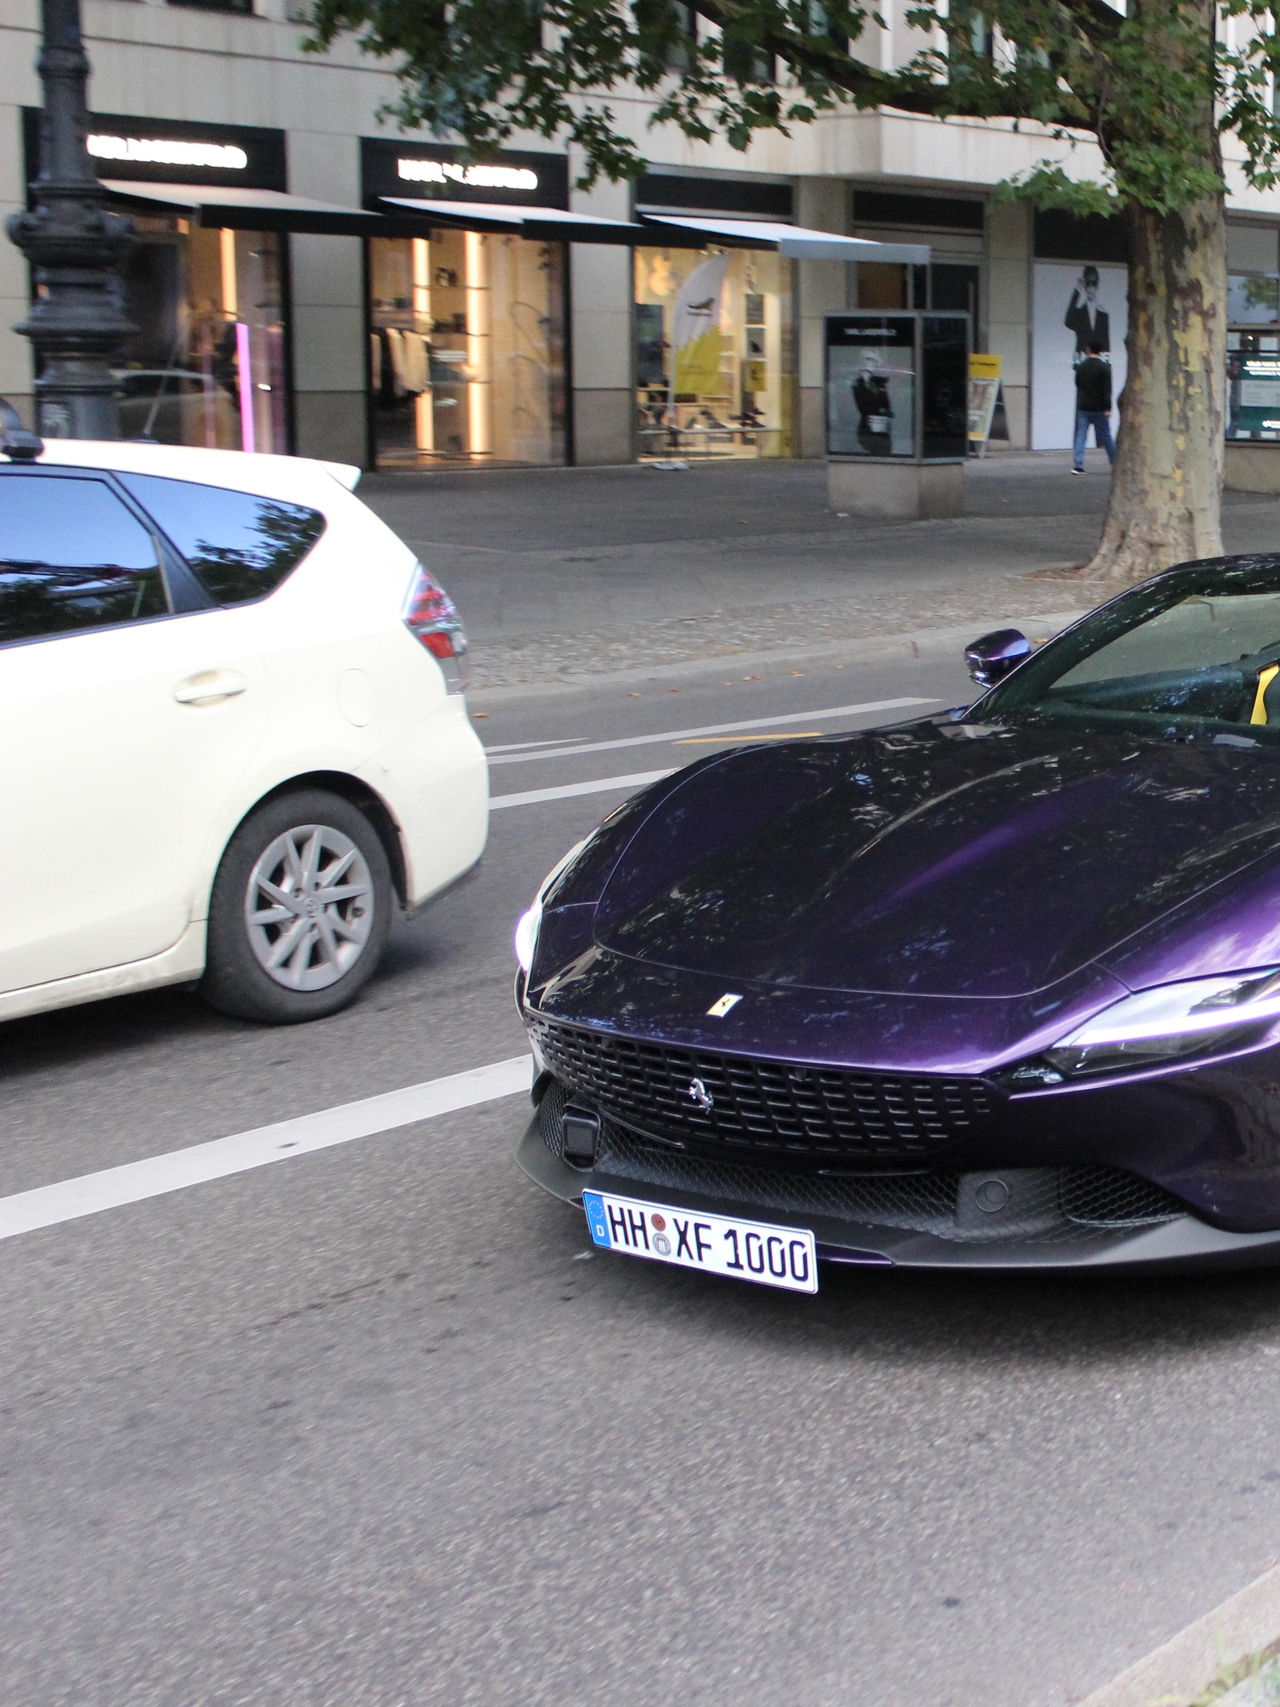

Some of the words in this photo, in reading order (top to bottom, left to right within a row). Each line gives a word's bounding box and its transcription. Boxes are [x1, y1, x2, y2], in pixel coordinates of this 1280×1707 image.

[596, 1225, 605, 1237] D
[607, 1204, 650, 1250] HH
[673, 1217, 712, 1262] XF
[723, 1228, 809, 1283] 1000
